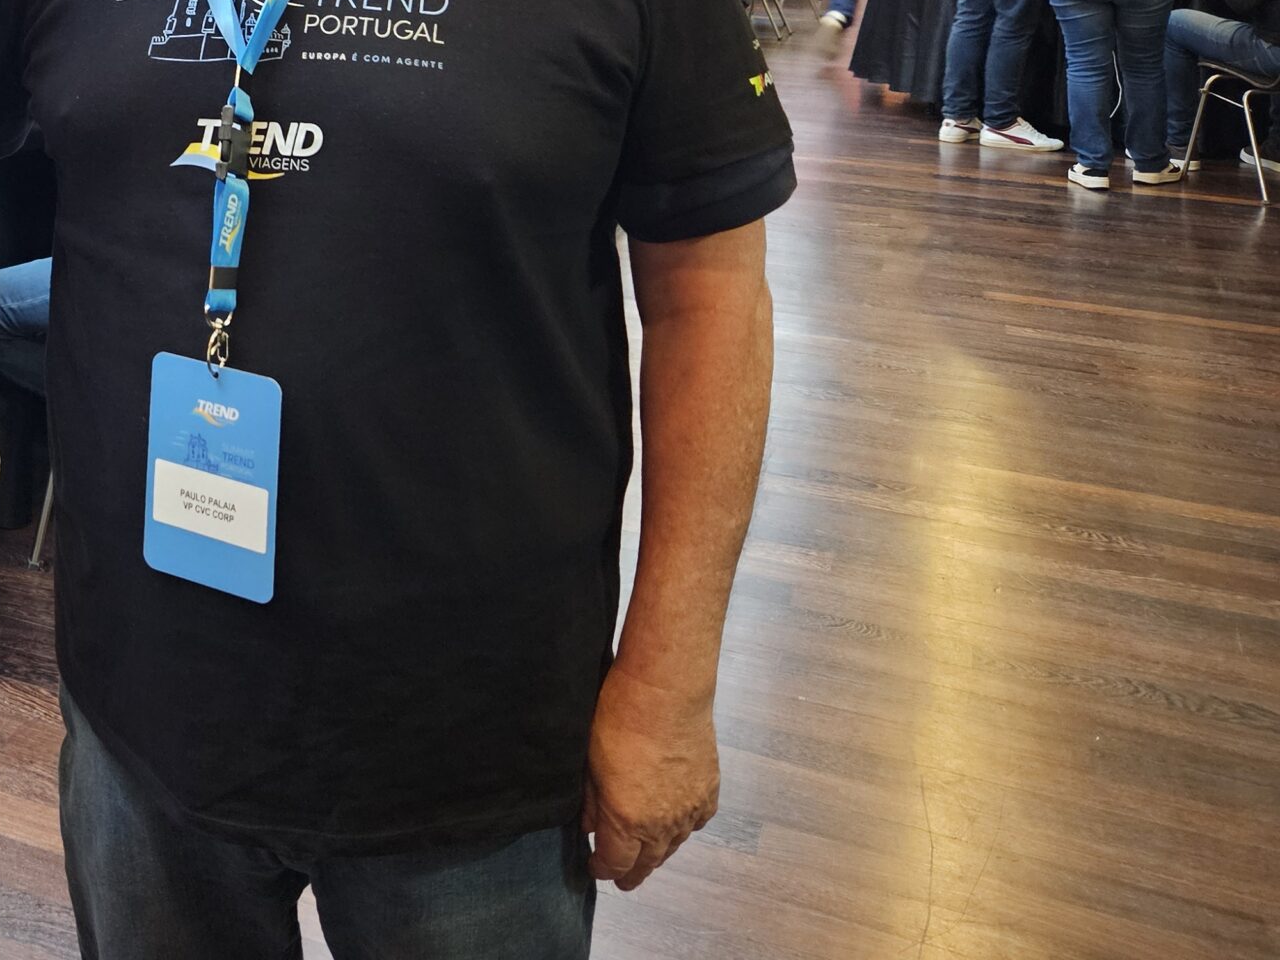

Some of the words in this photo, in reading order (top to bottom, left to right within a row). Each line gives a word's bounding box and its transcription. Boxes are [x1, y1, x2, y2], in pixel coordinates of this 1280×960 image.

[303, 14, 446, 45] PORTUGAL
[302, 51, 347, 61] EUROPA
[351, 52, 358, 62] É
[363, 54, 391, 64] COM
[396, 57, 445, 70] AGENTE
[197, 118, 324, 157] TEND
[249, 157, 310, 171] VIAGENS
[219, 194, 239, 247] TREND
[197, 399, 240, 421] TREND
[222, 451, 256, 470] TREND
[180, 488, 207, 503] PAULO
[183, 501, 193, 511] VP
[195, 504, 211, 517] CVC
[212, 510, 235, 523] CORP
